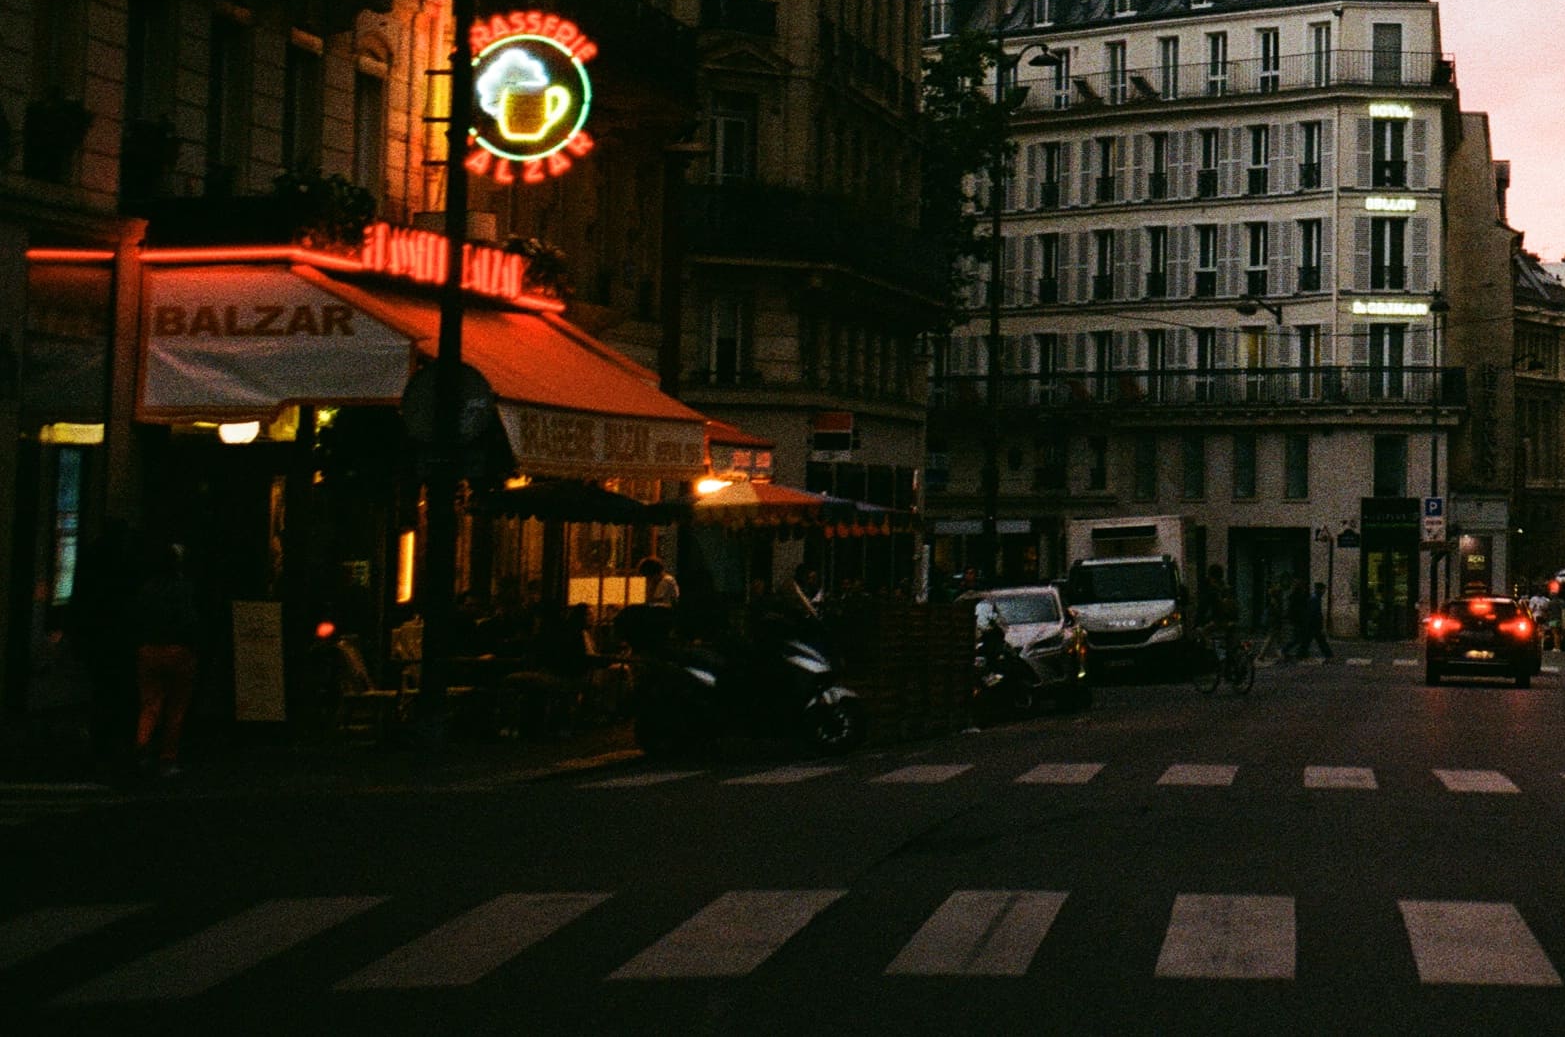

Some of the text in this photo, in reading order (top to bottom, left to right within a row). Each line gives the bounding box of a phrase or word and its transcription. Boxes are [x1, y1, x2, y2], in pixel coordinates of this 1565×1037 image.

[469, 10, 598, 63] RASSERIE
[464, 130, 594, 184] ALZAR
[154, 304, 355, 337] BALZAR
